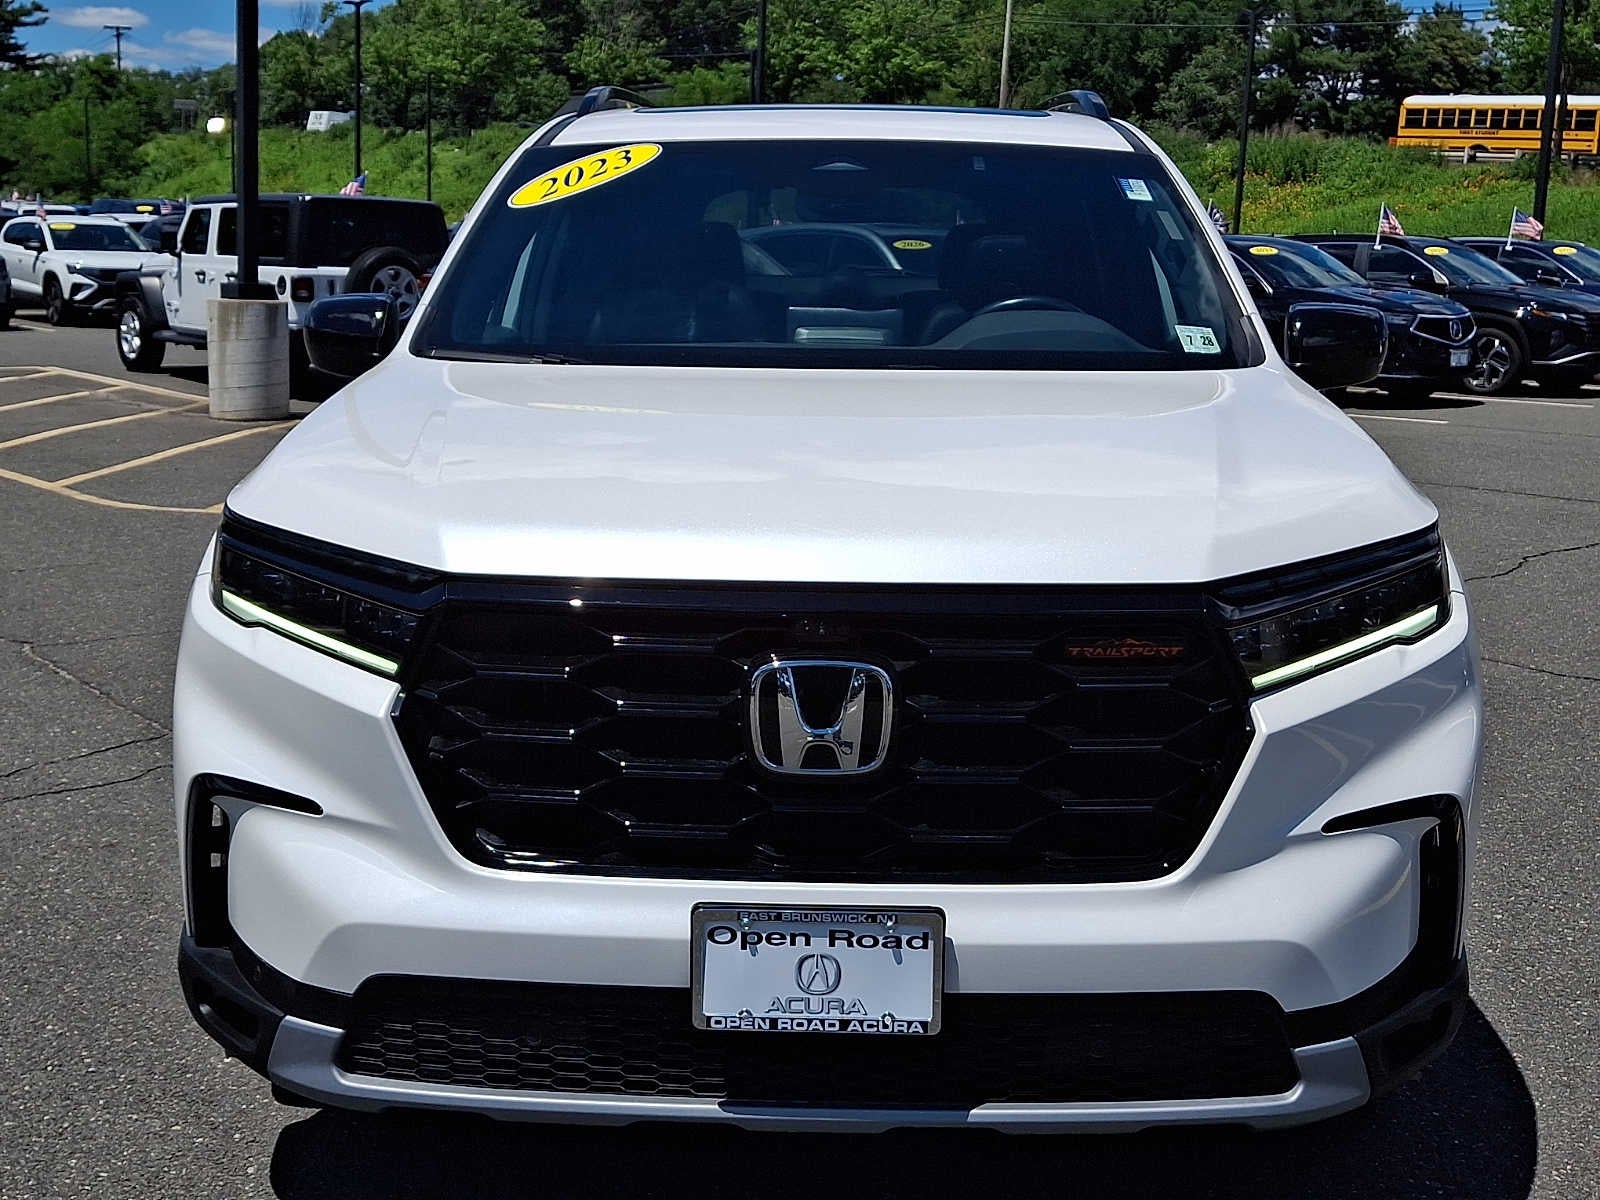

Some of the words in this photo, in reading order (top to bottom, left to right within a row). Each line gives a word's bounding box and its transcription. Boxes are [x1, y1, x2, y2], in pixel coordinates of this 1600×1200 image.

[539, 149, 632, 200] 2023
[1185, 334, 1193, 346] 7
[1199, 335, 1215, 347] 28
[1068, 646, 1185, 658] TRAILSPORT
[740, 911, 777, 922] EAST
[876, 914, 897, 925] NJ
[706, 925, 812, 951] Open
[828, 928, 930, 950] Road
[764, 996, 868, 1016] ACURA
[710, 1016, 771, 1031] OPEN
[777, 1018, 840, 1032] ROAD
[846, 1019, 925, 1034] ACURA
